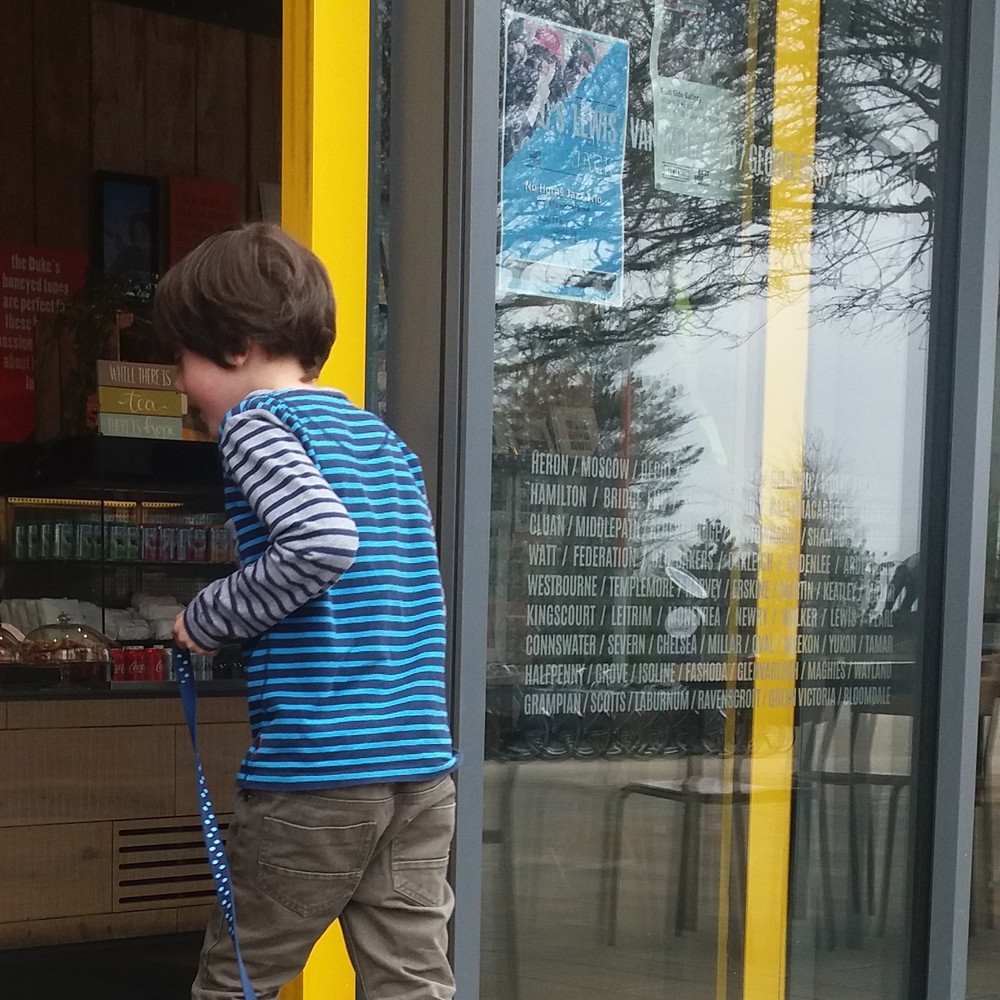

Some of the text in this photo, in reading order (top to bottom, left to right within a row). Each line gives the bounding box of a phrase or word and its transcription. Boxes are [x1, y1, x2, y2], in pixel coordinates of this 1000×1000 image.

[11, 253, 61, 275] the Duke's
[2, 273, 70, 296] honeyed tones
[3, 296, 19, 309] are
[21, 297, 54, 313] perfect
[5, 314, 32, 331] these
[3, 353, 30, 371] about
[109, 363, 172, 386] WHILE THERE IS
[118, 389, 165, 414] tea
[531, 452, 569, 477] HERON
[580, 455, 630, 480] MOSCOW
[530, 482, 587, 508] HAMILTON
[603, 486, 641, 510] BRIDGE
[529, 512, 566, 537] CLUAN
[528, 543, 558, 567] WATT
[573, 545, 637, 569] FEDERATION
[527, 573, 598, 598] WESTBOURNE
[608, 575, 675, 599] TEMPLEMORE
[526, 603, 597, 627] KINGSCOURT
[611, 605, 653, 627] LEITRIM
[830, 608, 857, 628] LEWIS
[526, 633, 597, 657] CONNSWATER
[607, 634, 646, 656] SEVERN
[656, 634, 697, 656] CHELSEA
[707, 634, 742, 655] MILLAR
[829, 634, 857, 655] YUKON
[865, 634, 894, 654] TAMAR
[525, 662, 584, 687] HALFPENNY
[595, 662, 629, 685] GROVE
[639, 662, 677, 684] ISOLINE
[685, 662, 728, 683] FASHODA
[807, 661, 846, 681] MAGHIES
[854, 662, 892, 680] WAYLAND
[523, 693, 582, 716] GRAMPIAN
[590, 692, 626, 713] SCOTTS
[634, 690, 690, 712] LABURNUM
[798, 687, 836, 707] VICTORIA
[843, 686, 892, 706] BLOOMDALE
